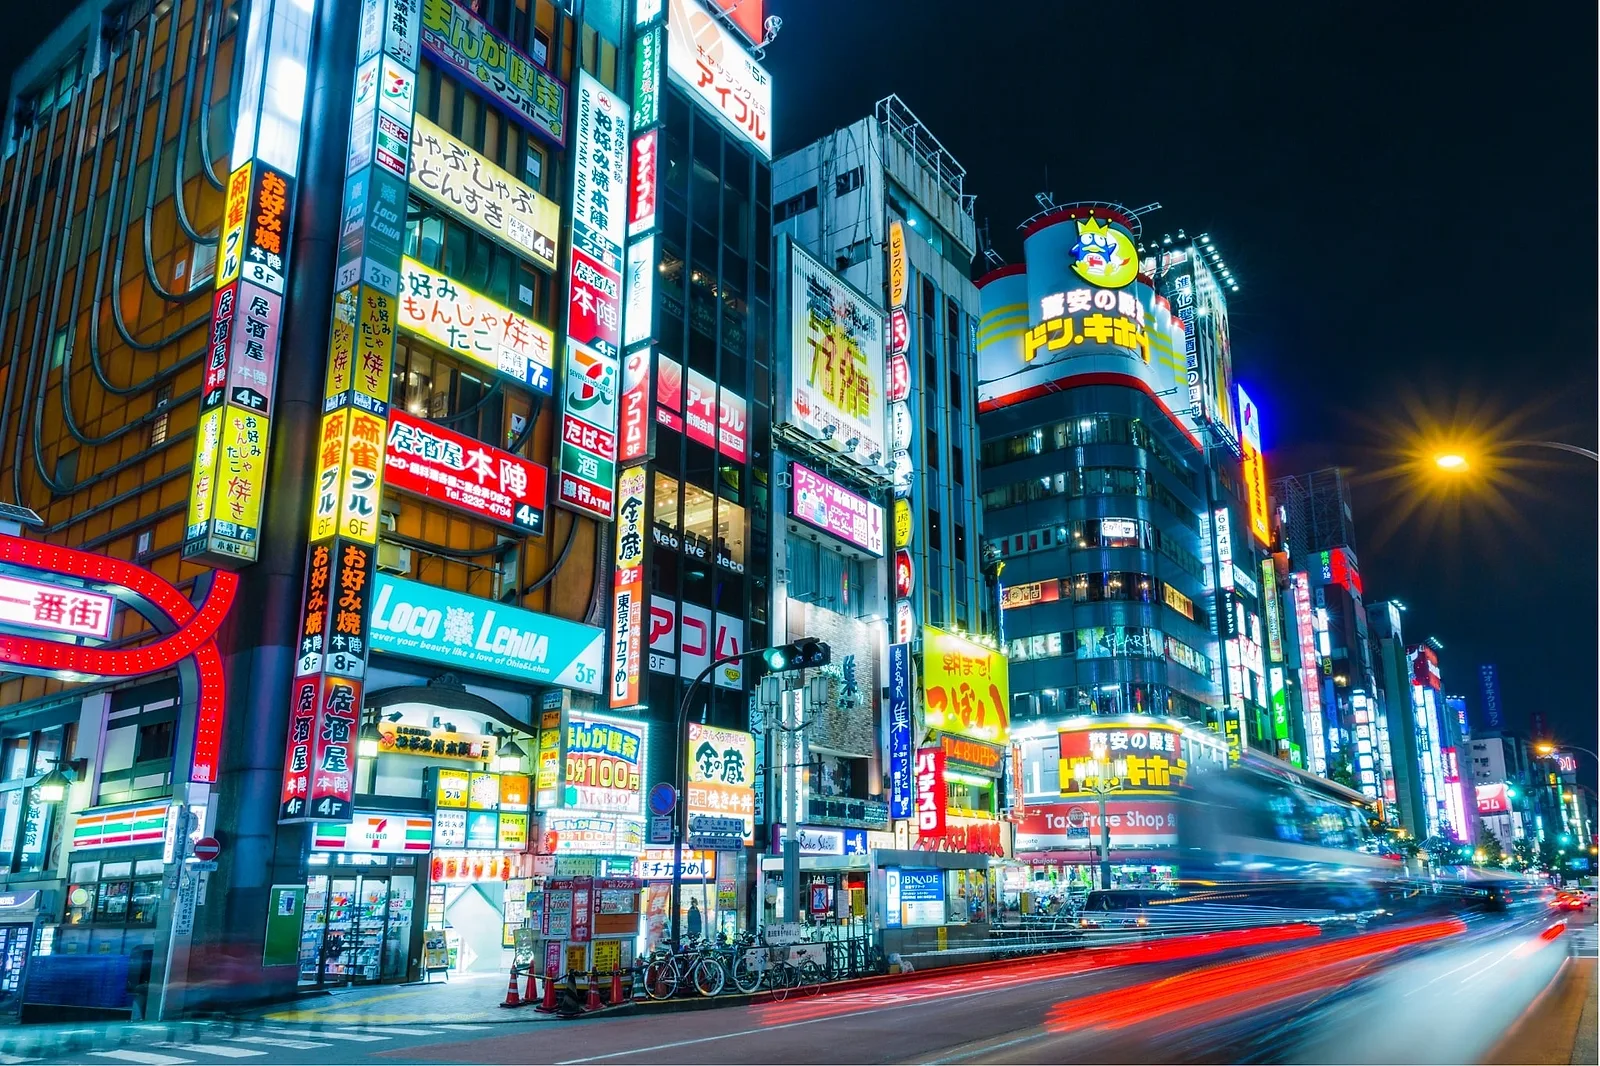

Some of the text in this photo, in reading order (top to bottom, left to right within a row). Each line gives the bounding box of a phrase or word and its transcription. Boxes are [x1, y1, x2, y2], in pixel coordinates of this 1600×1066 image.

[492, 75, 550, 124] マンボー
[696, 59, 767, 141] アイフル
[379, 115, 408, 143] たばこ
[385, 137, 400, 154] 酒
[576, 89, 590, 217] OKONOMIYAKI HONJIN
[635, 154, 651, 220] アイフル
[254, 171, 286, 254] お好み焼
[250, 246, 282, 270] 本陣
[533, 235, 554, 259] 4F
[582, 239, 603, 257] 2F
[252, 265, 276, 283] 8F
[340, 268, 357, 286] 3F
[370, 267, 392, 287] 3F
[574, 258, 619, 300] 居酒屋
[572, 286, 618, 333] 本陣
[211, 289, 233, 369] 居酒屋
[244, 296, 270, 363] 居酒屋
[403, 296, 549, 362] もんじゃ焼き
[447, 325, 493, 352] たこ
[595, 339, 616, 357] 4F
[237, 366, 268, 386] 本陣
[529, 358, 549, 390] 7F
[207, 390, 221, 405] 4F
[236, 389, 263, 408] 4F
[373, 399, 384, 413] 7F
[687, 384, 745, 432] アイフル
[626, 391, 642, 441] アコム
[658, 410, 672, 425] 5F
[246, 417, 261, 456] お好み
[565, 419, 614, 456] たばこ
[626, 443, 641, 457] 3F
[318, 414, 344, 514] 麻雀ブル
[348, 414, 380, 516] 麻雀ブル
[577, 452, 599, 480] 酒
[563, 478, 611, 512] 銀行ATM
[318, 518, 331, 535] 6F
[349, 518, 369, 536] 6F
[516, 505, 539, 527] 4F
[619, 496, 643, 561] 金の蔵
[239, 526, 252, 540] 7F
[870, 537, 881, 550] 1F
[305, 546, 329, 635] お好み焼
[336, 545, 368, 635] お好み焼
[621, 569, 638, 585] 2F
[0, 591, 103, 630] 一番街
[302, 635, 322, 652] 本陣
[331, 635, 362, 653] 本陣
[614, 593, 631, 697] 東京チカラめし
[650, 605, 741, 665] アコム
[303, 657, 317, 671] 8F
[333, 655, 357, 671] 8F
[397, 637, 419, 648] your
[421, 641, 451, 656] beauty
[452, 646, 467, 658] like
[476, 653, 494, 664] love
[495, 656, 506, 665] of
[649, 656, 666, 669] 3F
[575, 662, 597, 685] 3F
[292, 684, 315, 772] 居酒屋
[322, 684, 355, 773] 居酒屋
[695, 741, 746, 785] 金の蔵
[287, 777, 307, 793] 本陣
[316, 775, 348, 794] 本陣
[918, 753, 937, 832] パチスロ
[287, 798, 302, 815] 4F
[318, 798, 343, 816] 4F
[1126, 811, 1164, 831] Shop
